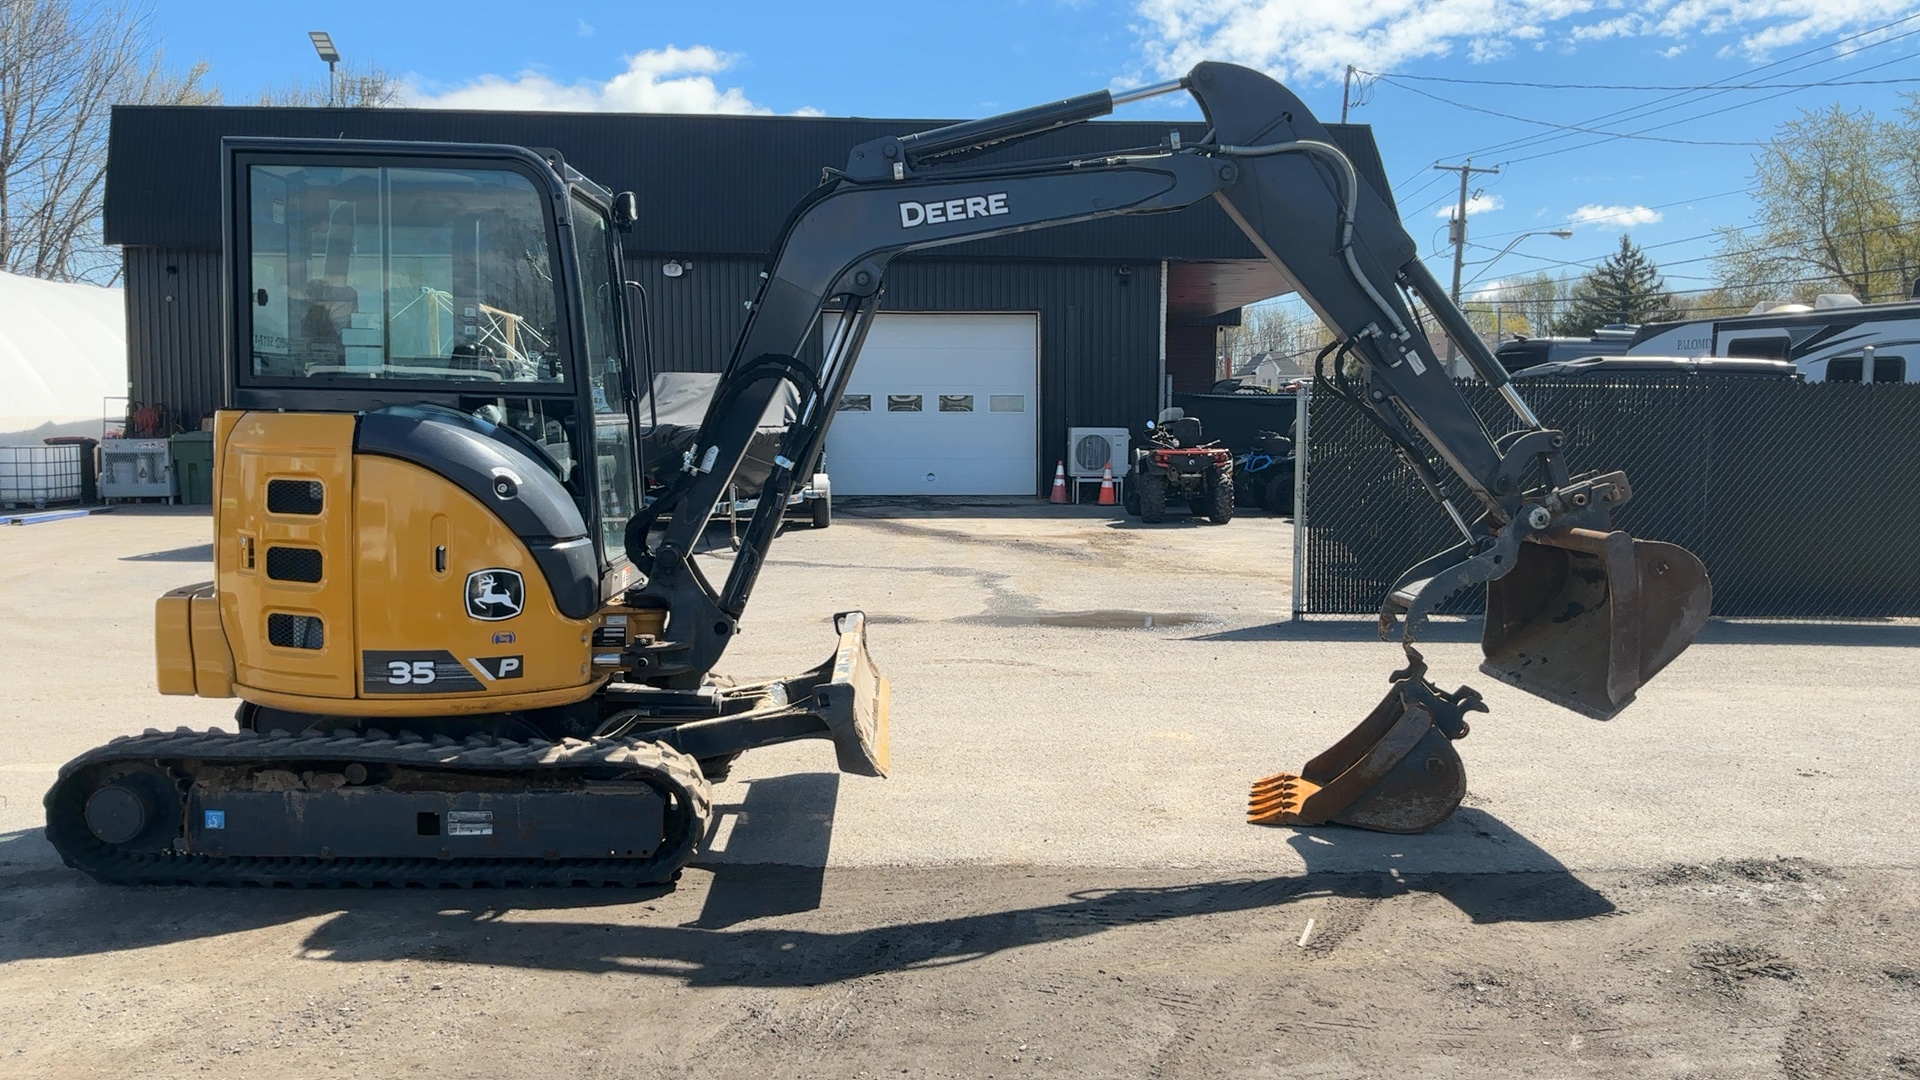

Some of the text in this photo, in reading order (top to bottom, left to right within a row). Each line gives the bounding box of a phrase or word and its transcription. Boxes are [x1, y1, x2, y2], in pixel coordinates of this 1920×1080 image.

[899, 193, 1009, 228] DEERE
[388, 658, 520, 685] 35 P
